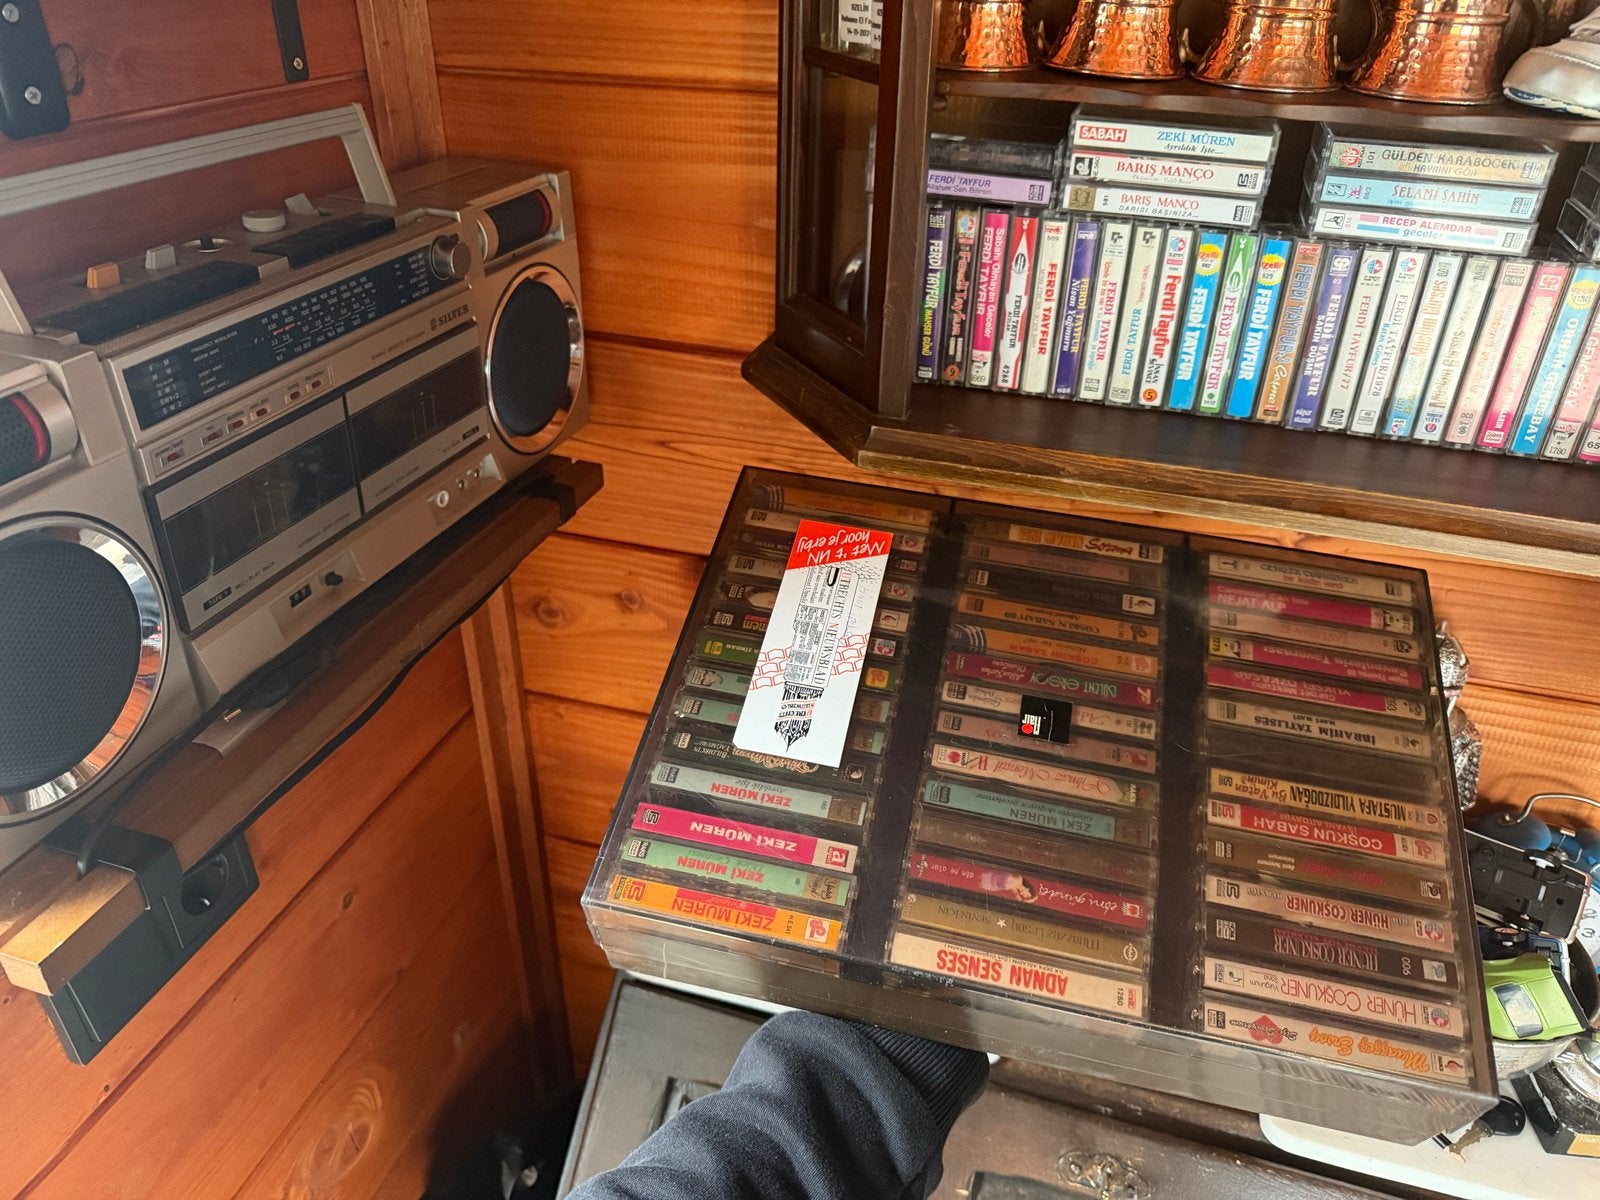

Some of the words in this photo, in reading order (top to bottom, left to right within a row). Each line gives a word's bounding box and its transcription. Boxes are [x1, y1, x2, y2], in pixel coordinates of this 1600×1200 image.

[1080, 127, 1126, 142] SABAH
[1157, 131, 1185, 141] ZEKİ
[1190, 133, 1235, 146] MÜREN
[1382, 149, 1432, 163] GÜLDEN
[959, 177, 991, 187] TAYFUR
[1117, 162, 1157, 176] BARIŞ
[1160, 165, 1214, 180] MANÇO
[1382, 216, 1416, 226] RECEP
[1420, 220, 1472, 234] ALEMDAR
[928, 240, 944, 269] FERDİ
[981, 227, 995, 263] FERDİ
[924, 271, 940, 309] TAYFUR
[976, 267, 989, 315] TAYFUR
[988, 264, 1000, 302] Olmayan
[1045, 263, 1058, 302] FERDİ
[1069, 279, 1081, 306] Nisan
[1077, 278, 1089, 310] FERDİ
[1163, 275, 1182, 311] Ferdi
[1013, 295, 1022, 318] FERDİ
[1105, 282, 1117, 315] FERDİ
[1190, 288, 1208, 328] FERDİ
[1249, 288, 1273, 330] FERDİ
[1389, 294, 1409, 327] FERDİ
[438, 304, 469, 326] SILVER
[984, 305, 995, 338] Geceler
[1218, 296, 1236, 337] FERDİ
[1322, 294, 1342, 339] FERDİ
[1355, 296, 1372, 329] FERDİ
[1009, 320, 1019, 348] TAYFUR
[1038, 307, 1052, 355] TAYFUR
[1070, 313, 1083, 353] TAYFUR
[1096, 320, 1110, 361] TAYFUR
[1122, 348, 1133, 375] FERDİ
[1128, 308, 1141, 345] TAYFUR
[1153, 313, 1175, 358] Tayfur
[1312, 315, 1325, 343] SAKIN
[1378, 322, 1390, 344] Batan
[1177, 331, 1201, 380] TAYFUR
[1237, 331, 1264, 381] TAYFUR
[1553, 317, 1579, 369] ORHAN
[1002, 364, 1010, 383] 4268
[1206, 341, 1227, 390] TAYFUR
[1306, 344, 1331, 397] TAYFUR
[1523, 374, 1562, 443] GENCEBAY
[796, 535, 827, 553] erbij
[829, 528, 844, 544] je
[843, 529, 870, 543] hoor
[852, 540, 885, 555] Met
[806, 550, 831, 563] UN
[813, 622, 839, 685] NIEUWSBLAD
[1021, 714, 1041, 735] flair
[1254, 715, 1313, 733] TATLISES
[1318, 726, 1376, 746] İBRAHİM
[711, 783, 759, 801] MÜREN
[761, 792, 792, 807] ZEKİ
[1234, 783, 1267, 799] Vatan
[1271, 789, 1288, 801] Bu
[1290, 785, 1356, 812] YILDIZDOĞAN
[1009, 808, 1057, 827] MÜREN
[1358, 797, 1407, 822] MUSTAFA
[690, 821, 752, 841] MÜREN
[1059, 820, 1092, 834] ZEKİ
[1253, 815, 1310, 837] SABAH
[1312, 827, 1382, 851] COŞKUN
[756, 835, 797, 852] ZEKİ
[677, 855, 728, 876] MÜREN
[731, 867, 764, 883] ZEKİ
[671, 898, 732, 923] MÜREN
[735, 911, 775, 931] ZEKİ
[1285, 895, 1347, 921] COŞKUNER
[1349, 907, 1390, 930] HÜNER
[1337, 947, 1379, 972] HÜNER
[1009, 964, 1068, 996] ADNAN
[1280, 978, 1361, 1013] COŞKUNER
[1366, 995, 1417, 1024] HÜNER
